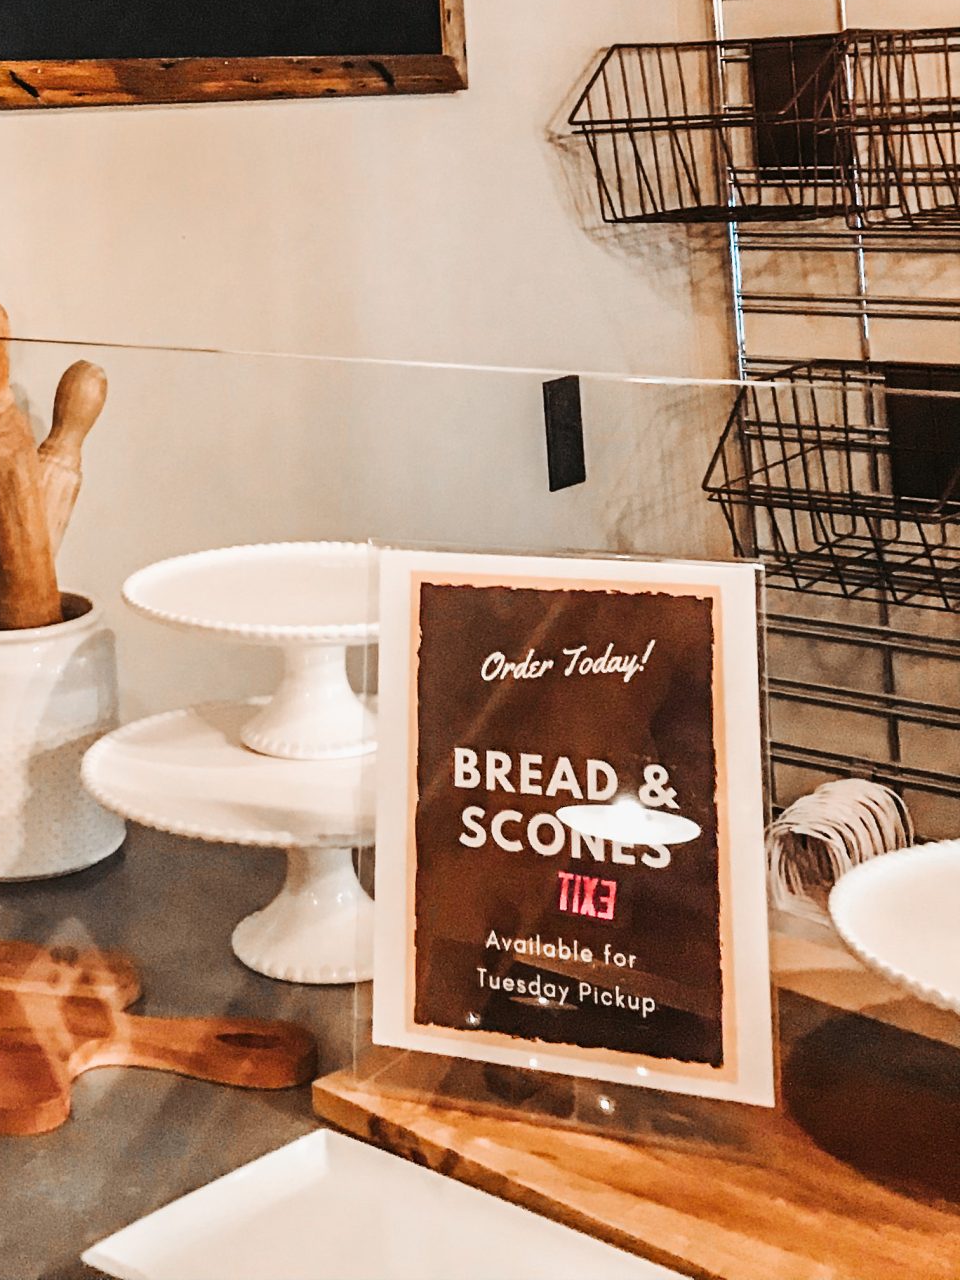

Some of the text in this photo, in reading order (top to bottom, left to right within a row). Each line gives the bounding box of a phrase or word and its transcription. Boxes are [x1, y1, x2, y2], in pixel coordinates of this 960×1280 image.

[481, 640, 655, 682] Order Today!
[454, 747, 680, 809] BREAD &
[486, 930, 636, 968] Available for
[477, 967, 655, 1018] Tuesday Pickup
